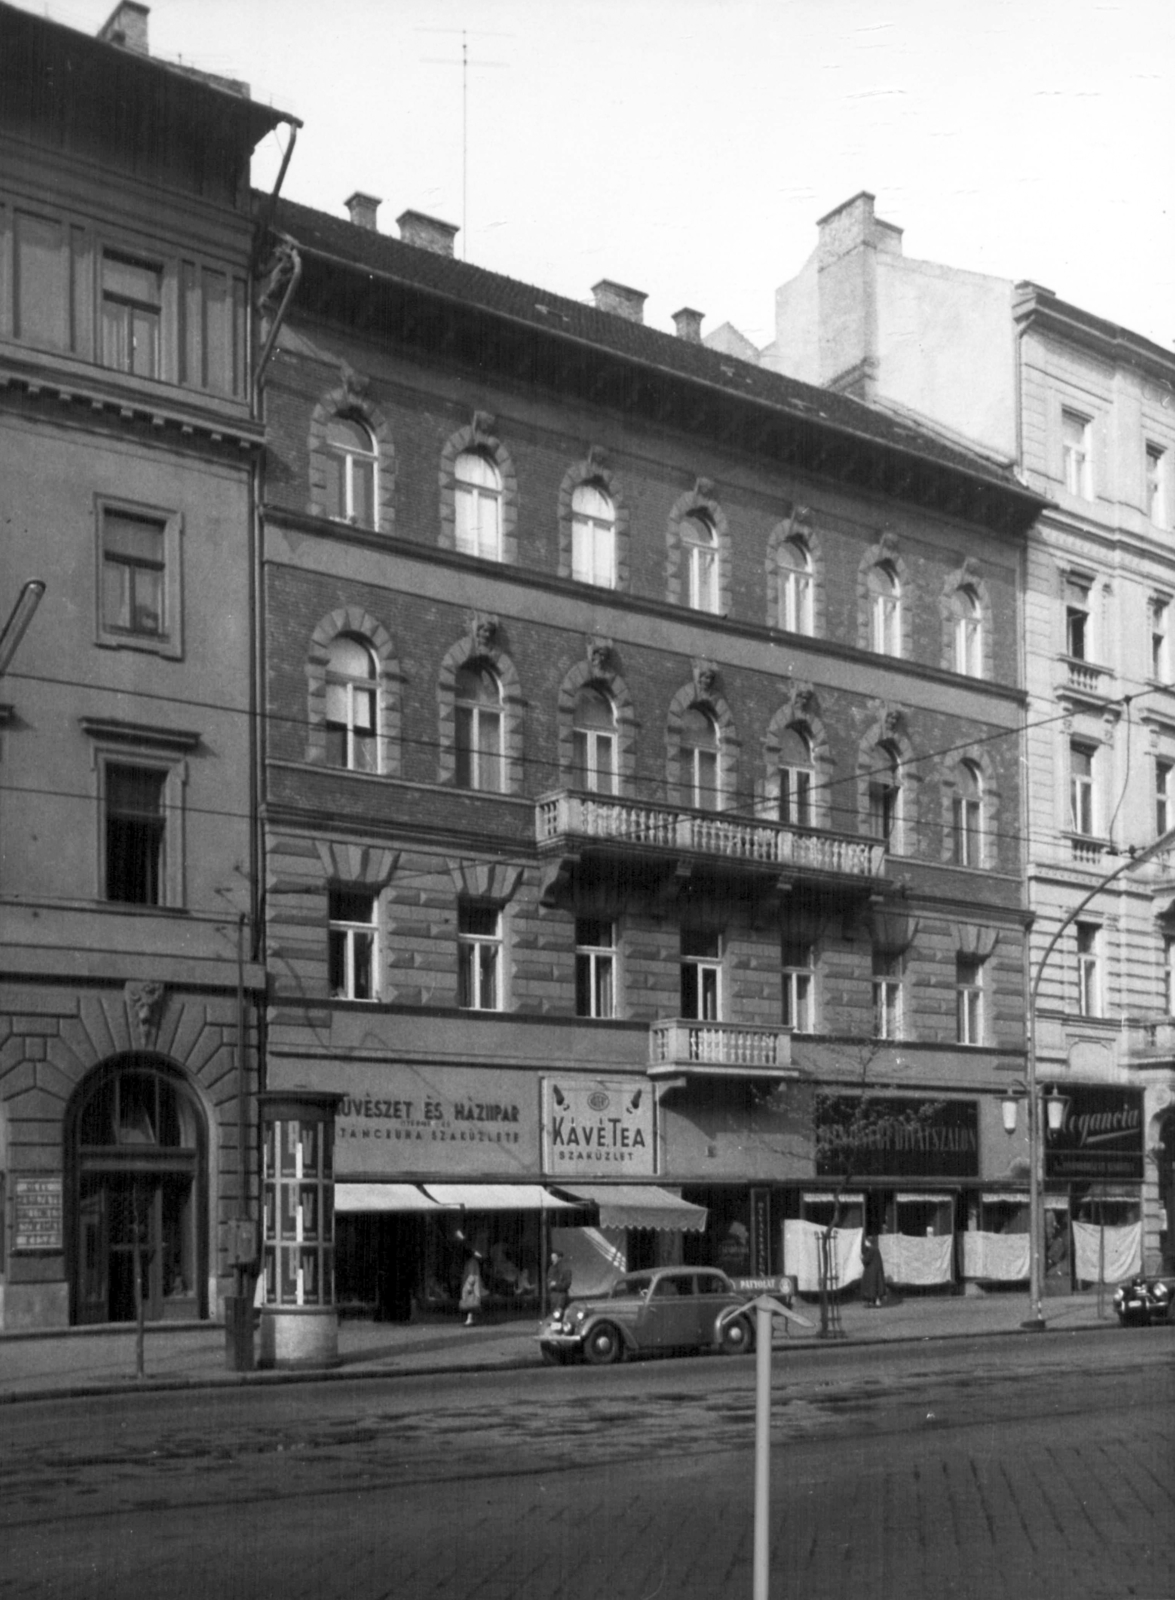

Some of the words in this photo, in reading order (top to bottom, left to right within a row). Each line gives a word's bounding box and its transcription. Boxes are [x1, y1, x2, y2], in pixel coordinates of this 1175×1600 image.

[424, 1095, 443, 1120] ÉS
[454, 1096, 520, 1122] HÁZIIPAR
[1046, 1100, 1139, 1148] legancia
[558, 1148, 634, 1162] SZAKÜZLET
